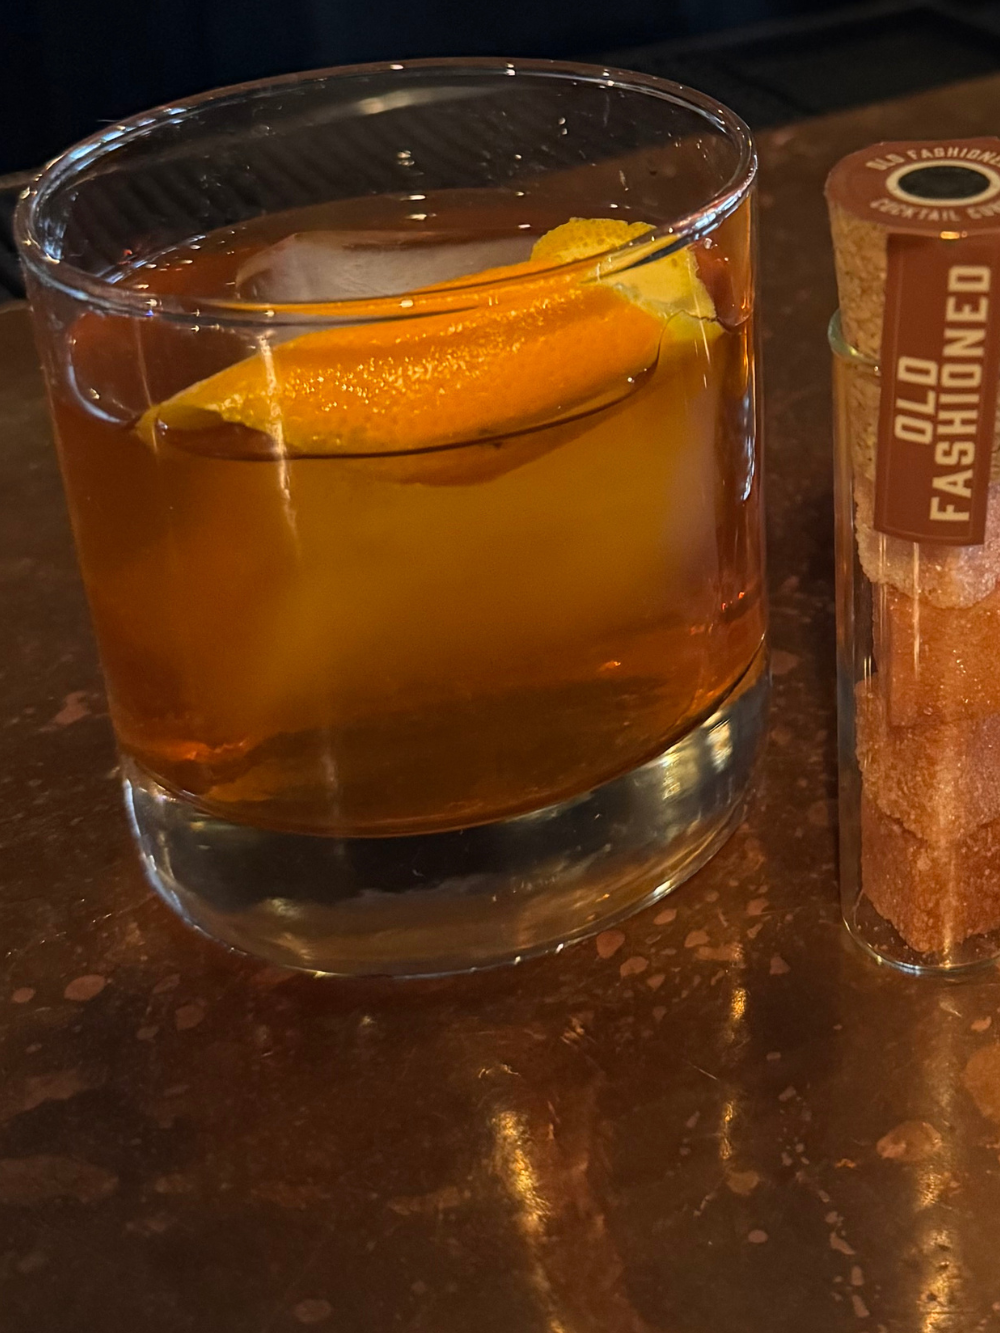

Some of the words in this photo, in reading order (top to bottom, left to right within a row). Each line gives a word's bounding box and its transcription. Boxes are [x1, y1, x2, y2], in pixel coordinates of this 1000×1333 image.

[865, 153, 905, 171] OLD
[894, 356, 939, 445] OLD
[929, 265, 992, 522] FASHIONED
